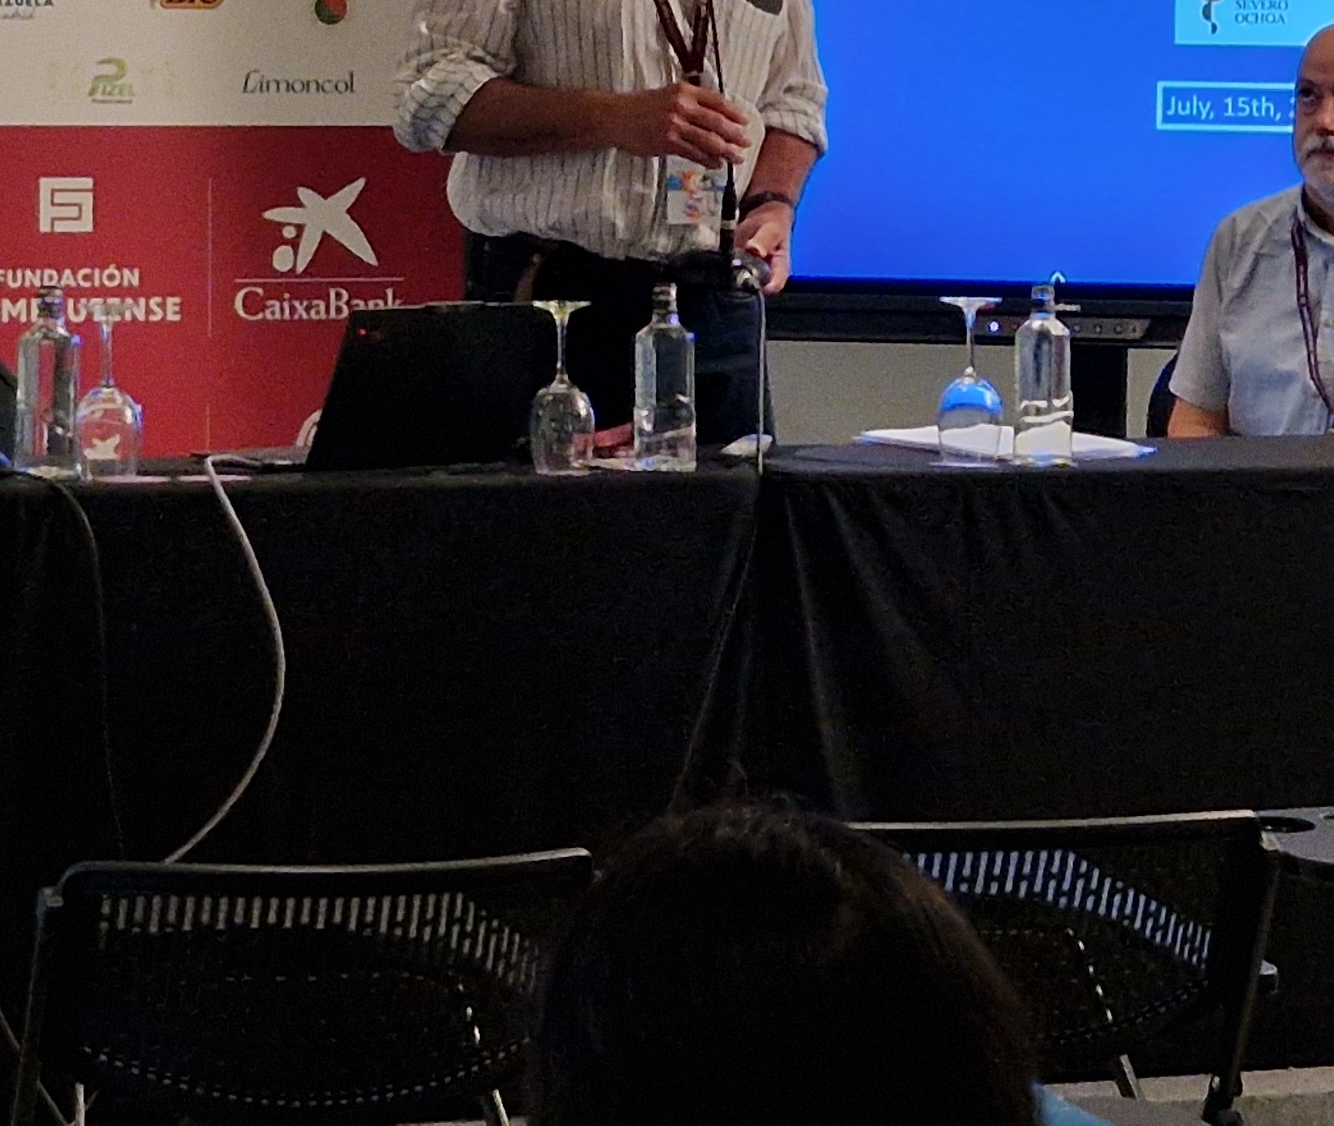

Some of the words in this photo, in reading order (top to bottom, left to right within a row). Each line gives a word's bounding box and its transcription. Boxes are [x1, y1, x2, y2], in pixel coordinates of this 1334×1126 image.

[1235, 0, 1289, 11] SEVERO
[1234, 12, 1286, 24] OCHOA
[242, 68, 355, 96] Limoncol
[1167, 94, 1215, 120] July,
[1223, 95, 1282, 121] 15th,
